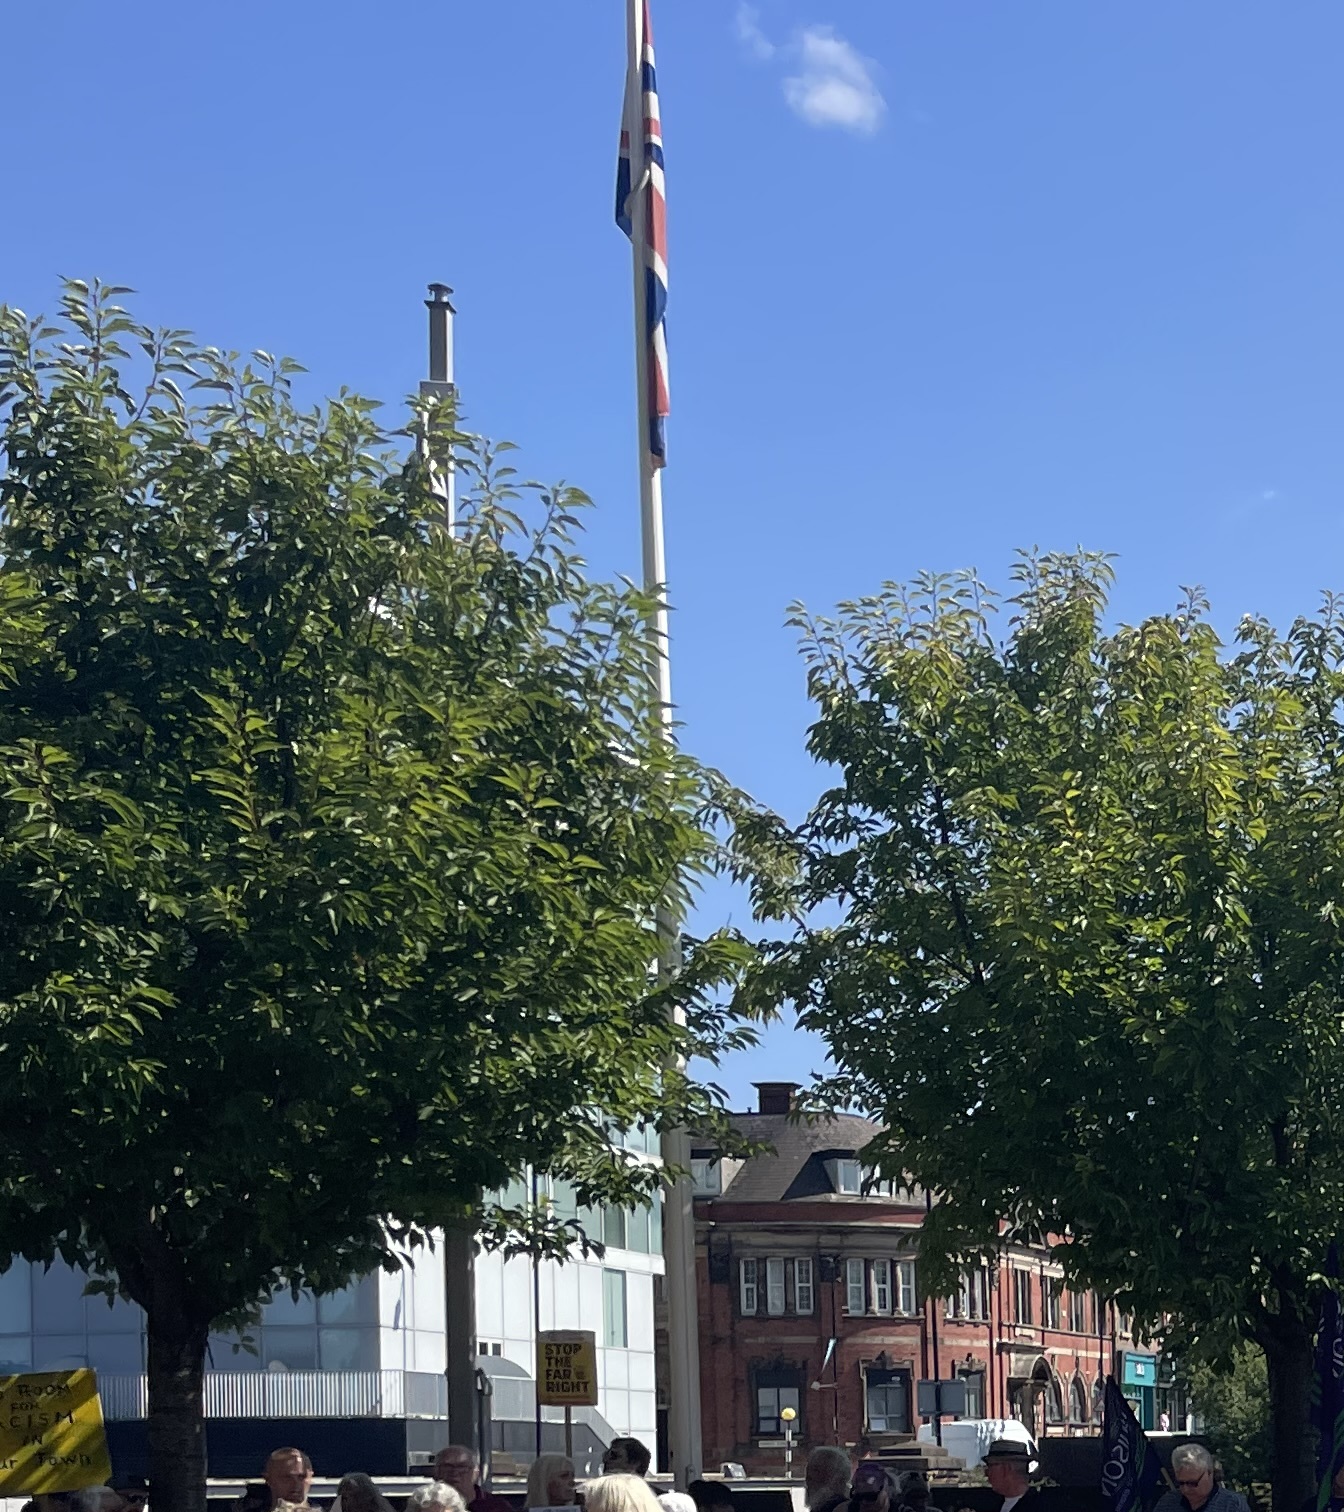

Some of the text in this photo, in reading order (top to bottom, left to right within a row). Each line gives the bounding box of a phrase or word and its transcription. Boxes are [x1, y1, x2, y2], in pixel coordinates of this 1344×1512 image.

[545, 1343, 582, 1355] STOP
[545, 1356, 572, 1368] THE
[545, 1369, 572, 1380] FAR
[546, 1381, 590, 1393] RIGHT
[0, 1409, 75, 1430] CISM
